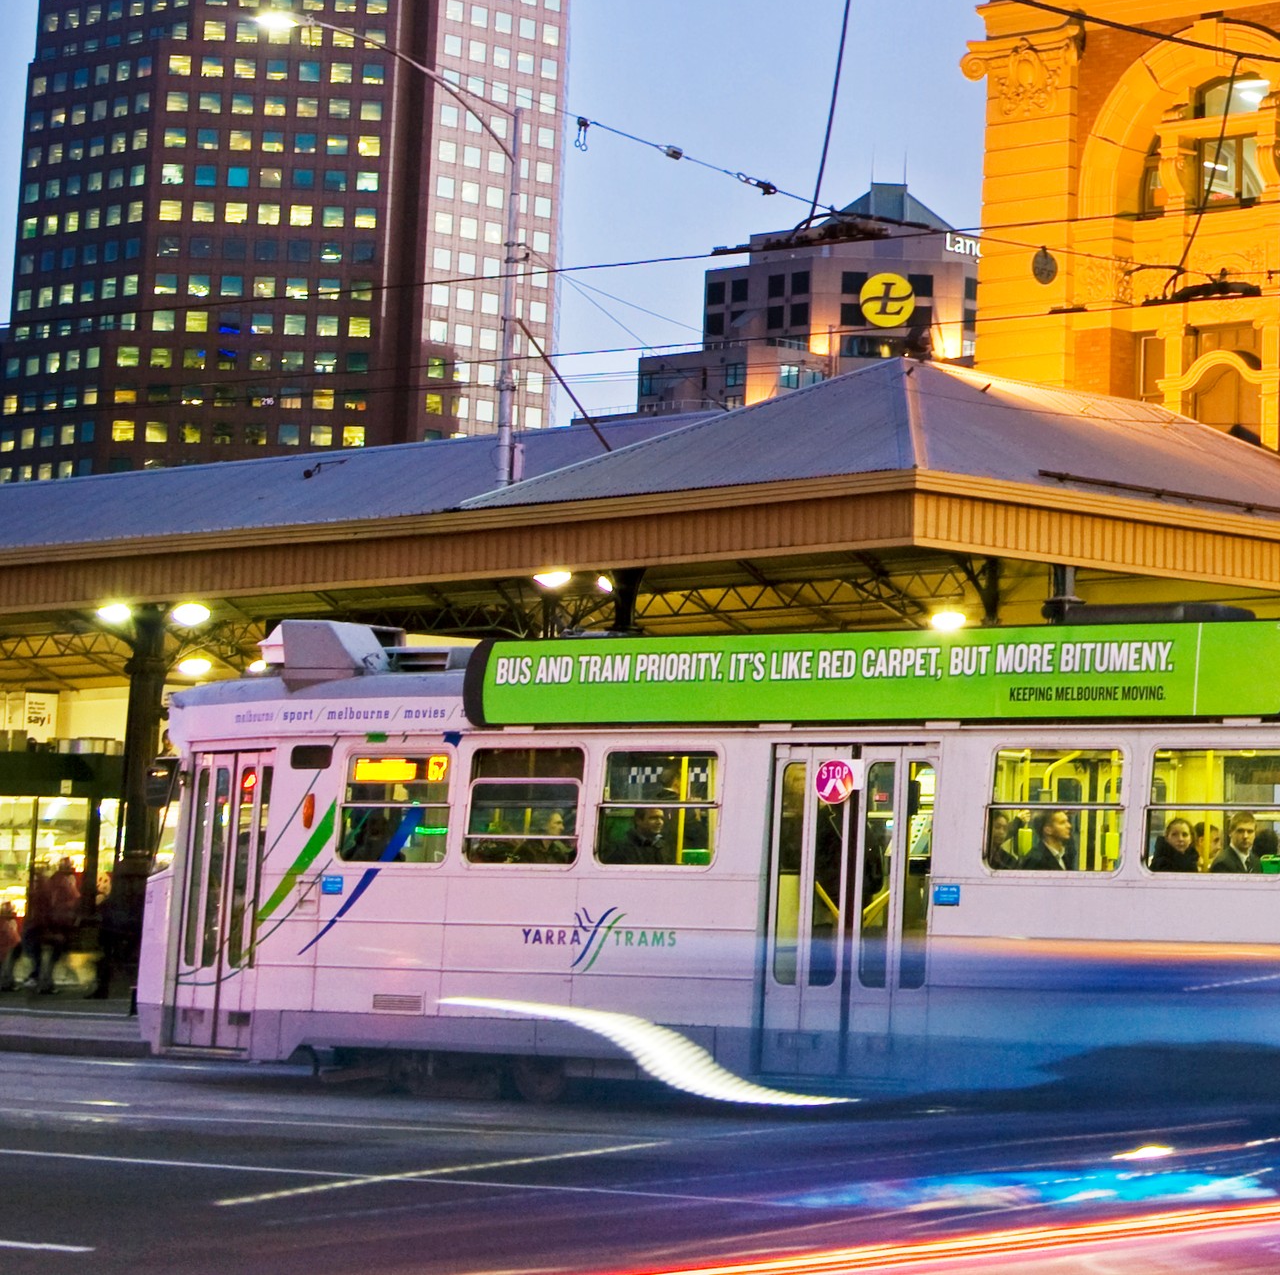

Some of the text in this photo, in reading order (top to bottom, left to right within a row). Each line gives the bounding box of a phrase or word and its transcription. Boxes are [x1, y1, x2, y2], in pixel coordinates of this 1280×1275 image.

[495, 641, 1174, 685] BUS AND TRAM PRIORITY. IT'S LIKE RED CARPET, BUT MORE BITUMENY.
[1009, 685, 1166, 701] KEEPING MELBOURNE MOVING.
[27, 715, 46, 727] say
[282, 709, 313, 723] sport
[327, 707, 390, 720] melbourne
[403, 707, 446, 720] movies
[427, 755, 448, 782] 67
[822, 766, 849, 780] STOP
[522, 928, 677, 947] YARRA TRAMS
